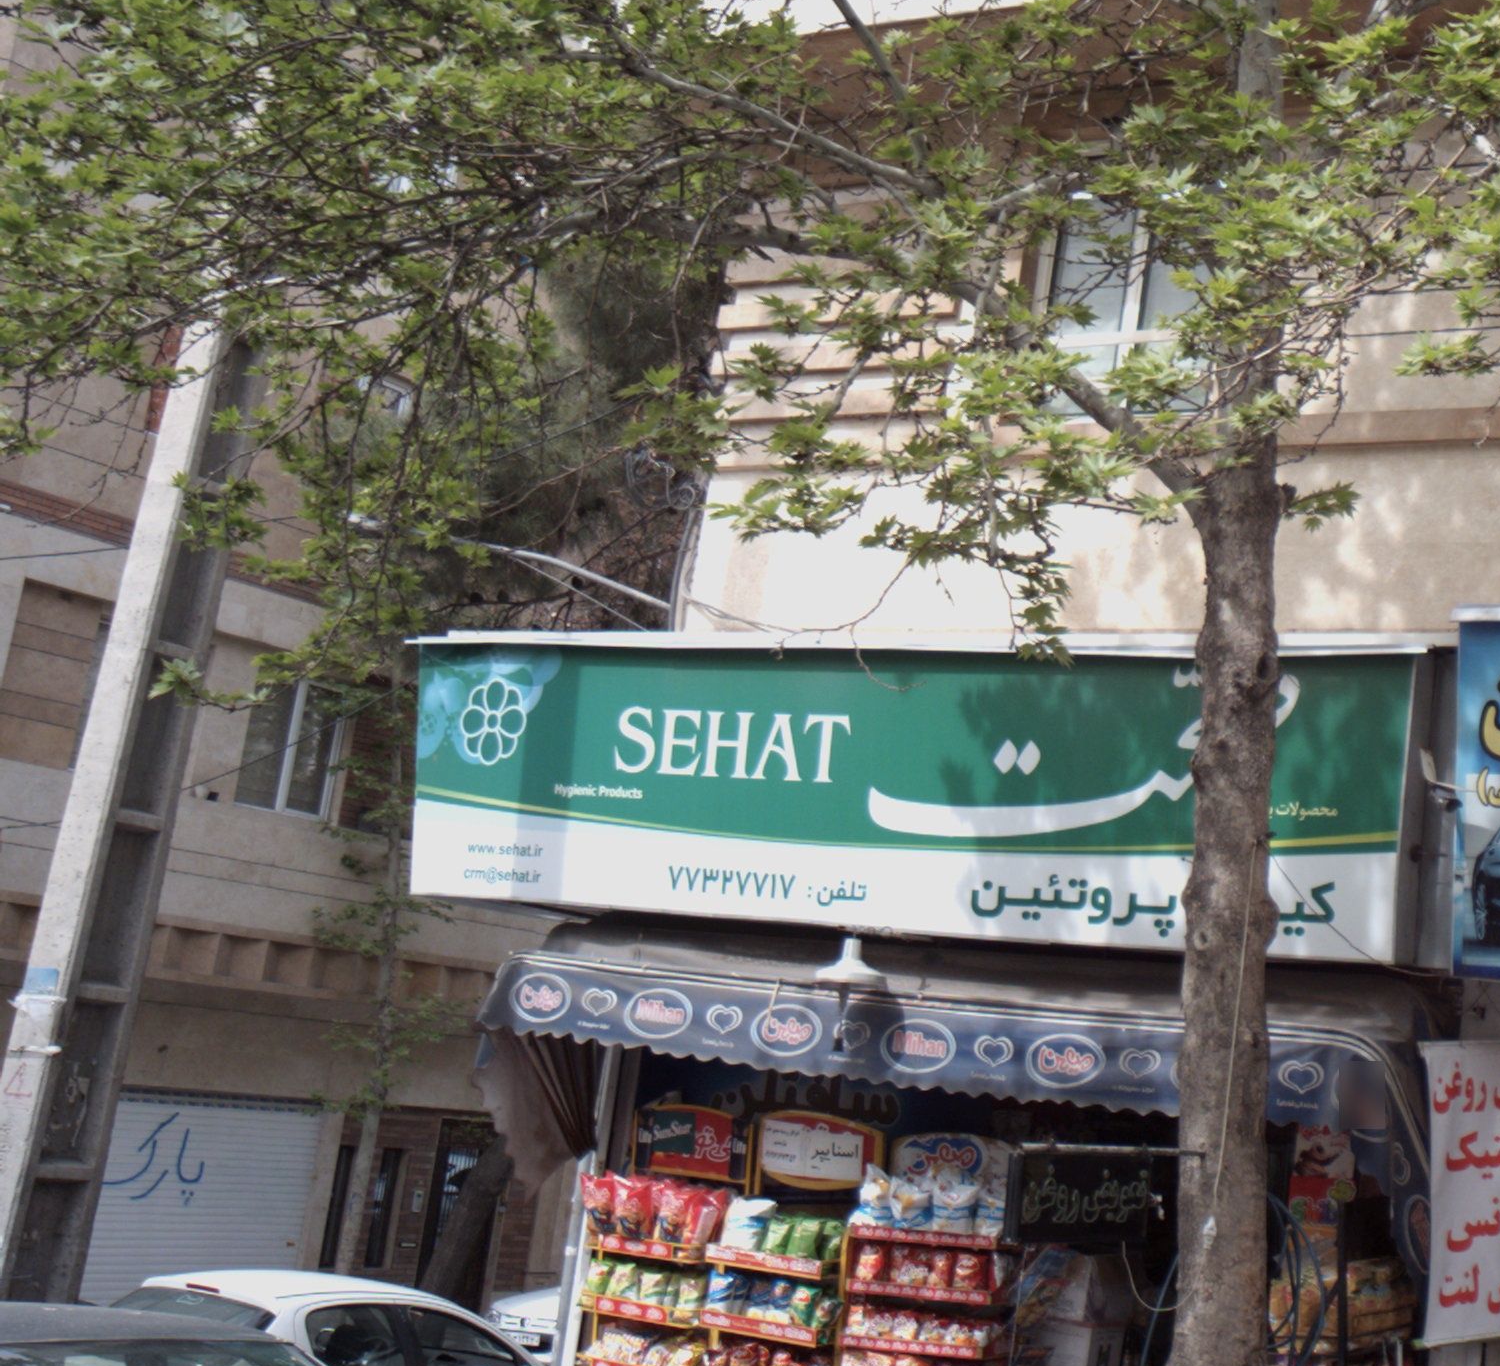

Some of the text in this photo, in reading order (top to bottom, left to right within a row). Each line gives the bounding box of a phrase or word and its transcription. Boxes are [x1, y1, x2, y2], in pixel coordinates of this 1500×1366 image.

[614, 705, 852, 784] SEHAT
[554, 783, 643, 799] Hygienic Products
[1276, 801, 1338, 821] محصولات
[468, 842, 543, 857] www.sehat.ir
[463, 866, 541, 884] crm@sehat.ir
[669, 865, 796, 899] ۷۷۳۲۷۷۱۷
[971, 874, 1177, 936] پروتئین
[636, 998, 685, 1026] Mihan
[892, 1029, 946, 1059] Mihan
[1432, 1061, 1488, 1114] روغن
[1438, 1264, 1480, 1308] لنت
